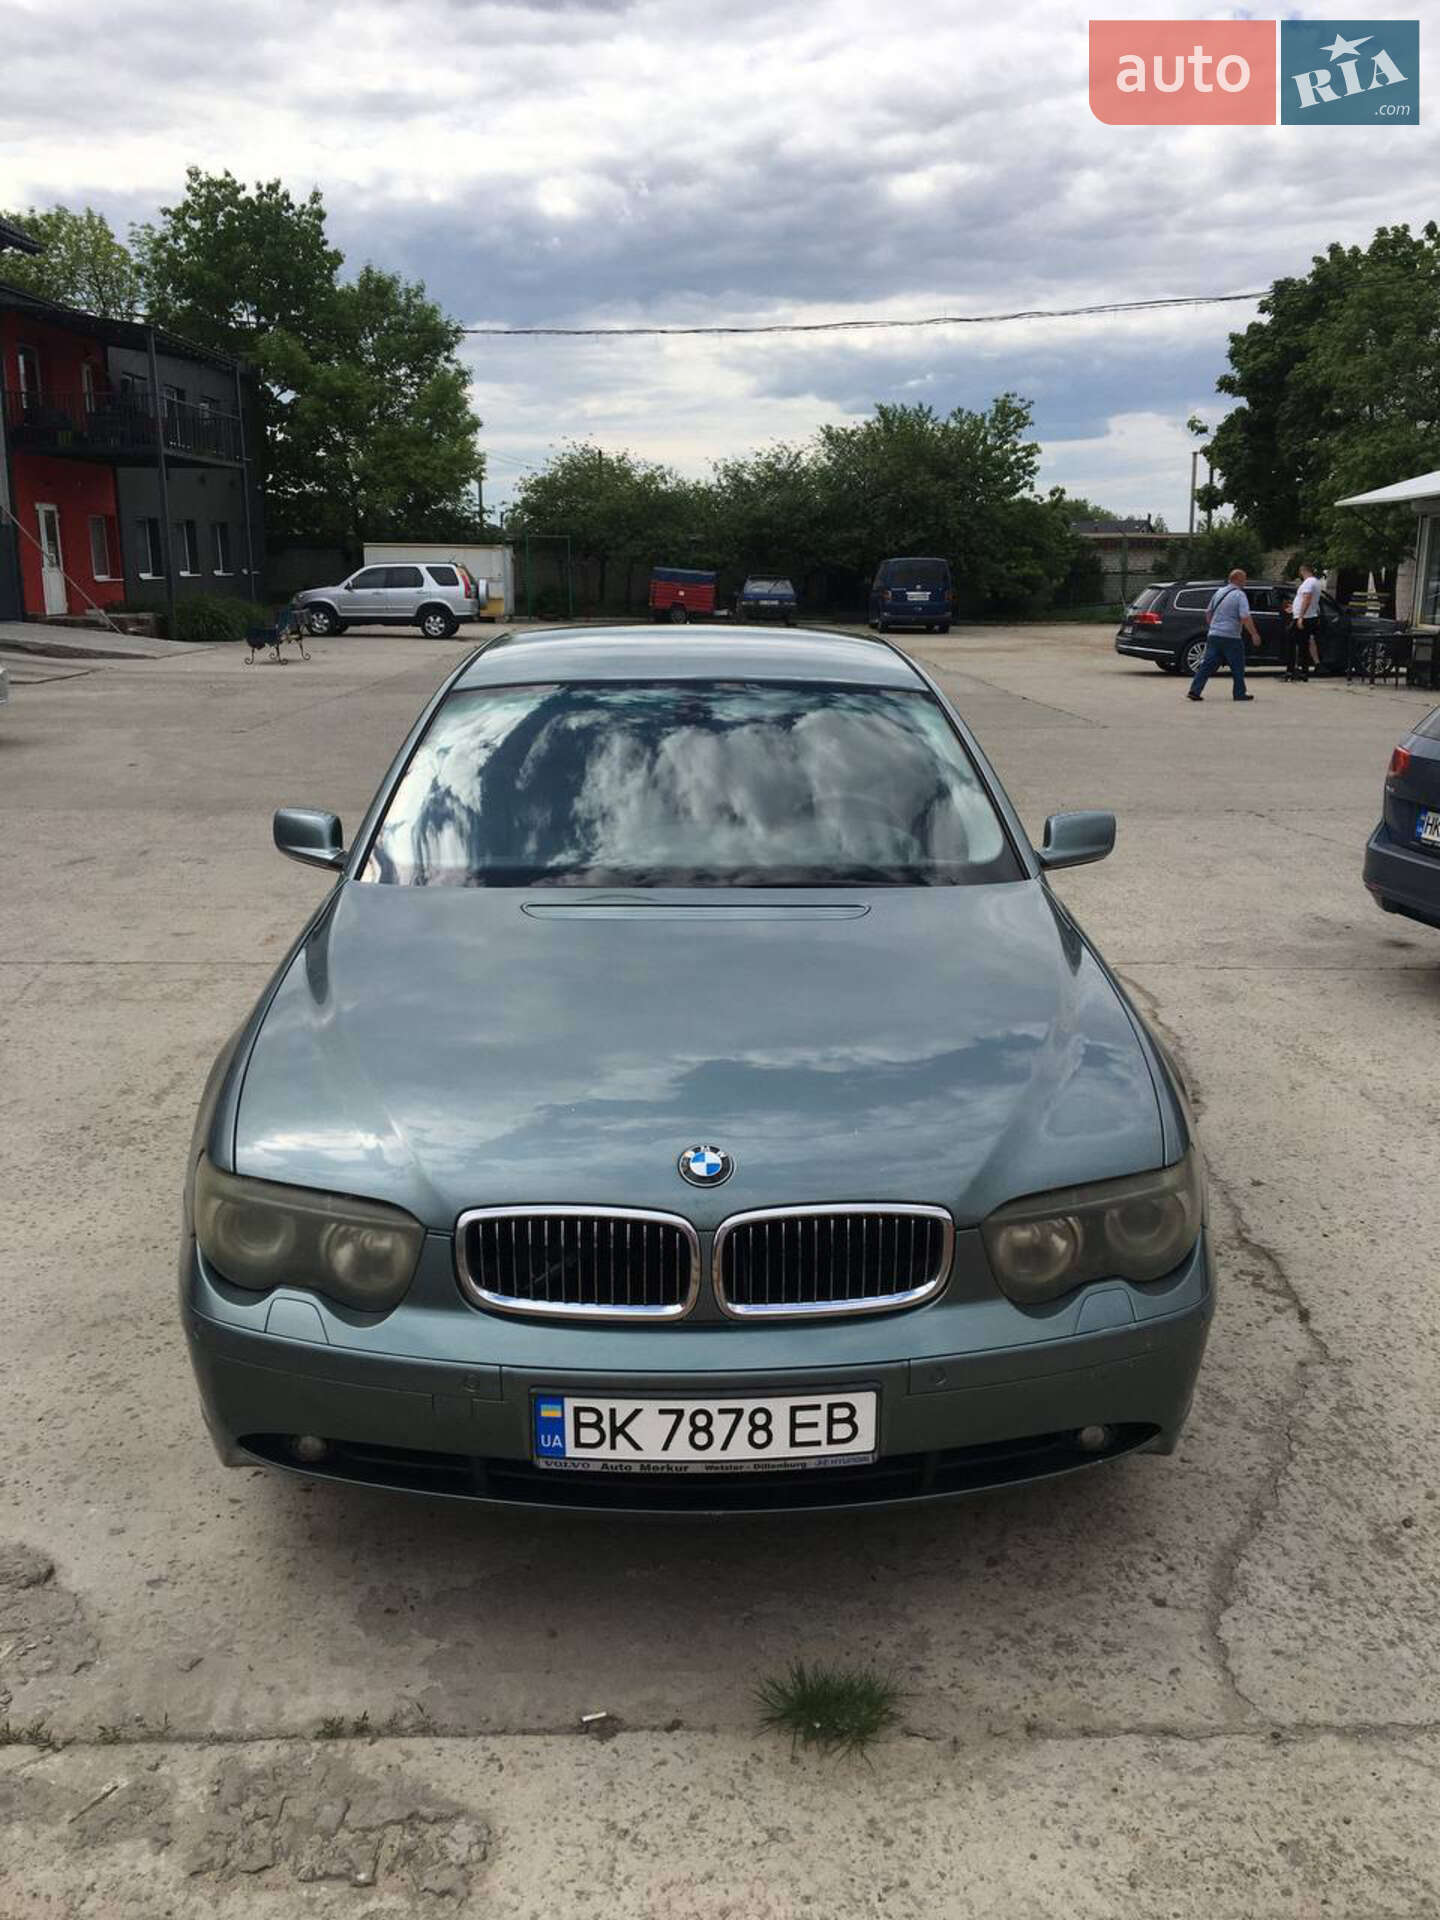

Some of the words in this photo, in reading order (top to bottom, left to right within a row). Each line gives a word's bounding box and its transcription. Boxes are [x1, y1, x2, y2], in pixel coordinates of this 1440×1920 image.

[573, 1405, 643, 1451] BK
[658, 1406, 773, 1451] 7878
[789, 1401, 859, 1448] EB
[541, 1434, 563, 1448] UA
[600, 1462, 633, 1472] Auto
[640, 1462, 690, 1472] Merkur
